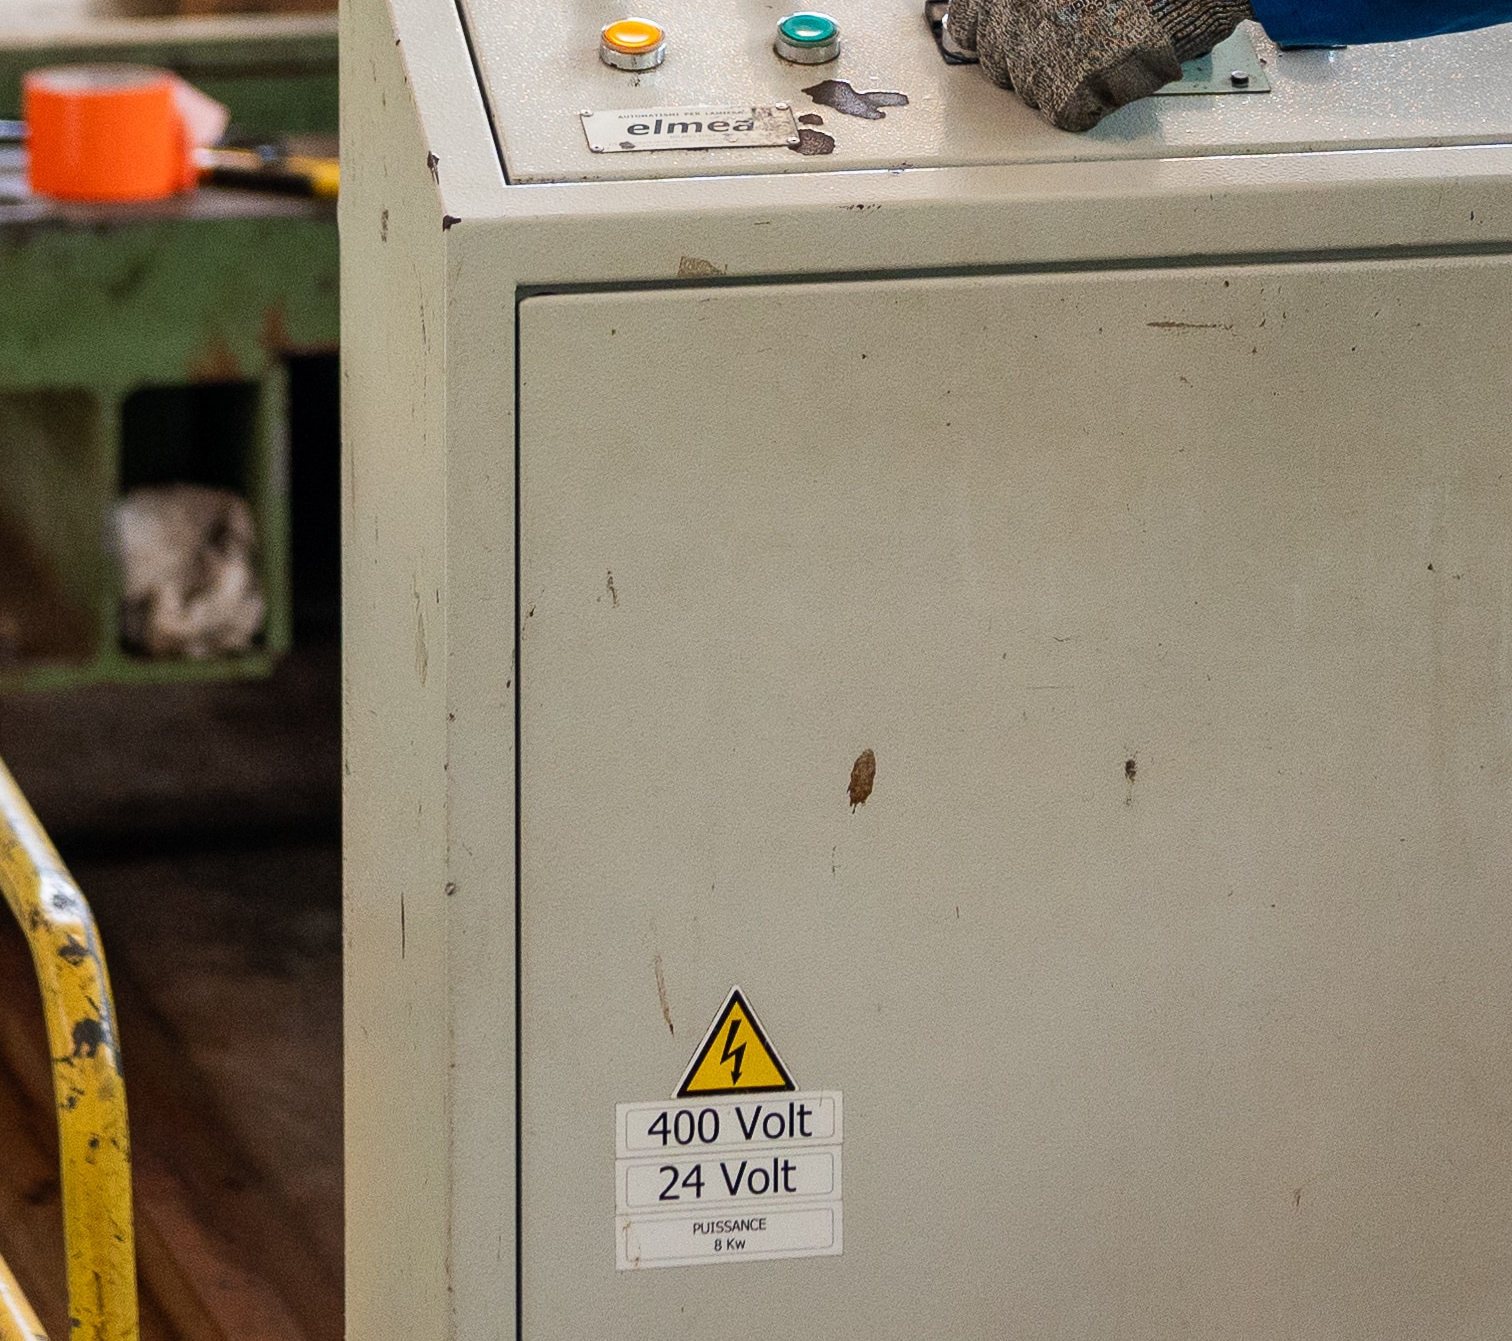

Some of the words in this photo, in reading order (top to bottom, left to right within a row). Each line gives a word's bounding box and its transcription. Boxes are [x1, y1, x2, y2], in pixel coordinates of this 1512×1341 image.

[626, 117, 754, 136] elmea
[647, 1108, 720, 1146] 400
[735, 1102, 813, 1140] Volt
[658, 1164, 705, 1201] 24
[720, 1157, 797, 1196] Volt
[692, 1218, 767, 1235] PUISSANCE
[713, 1239, 722, 1252] 8
